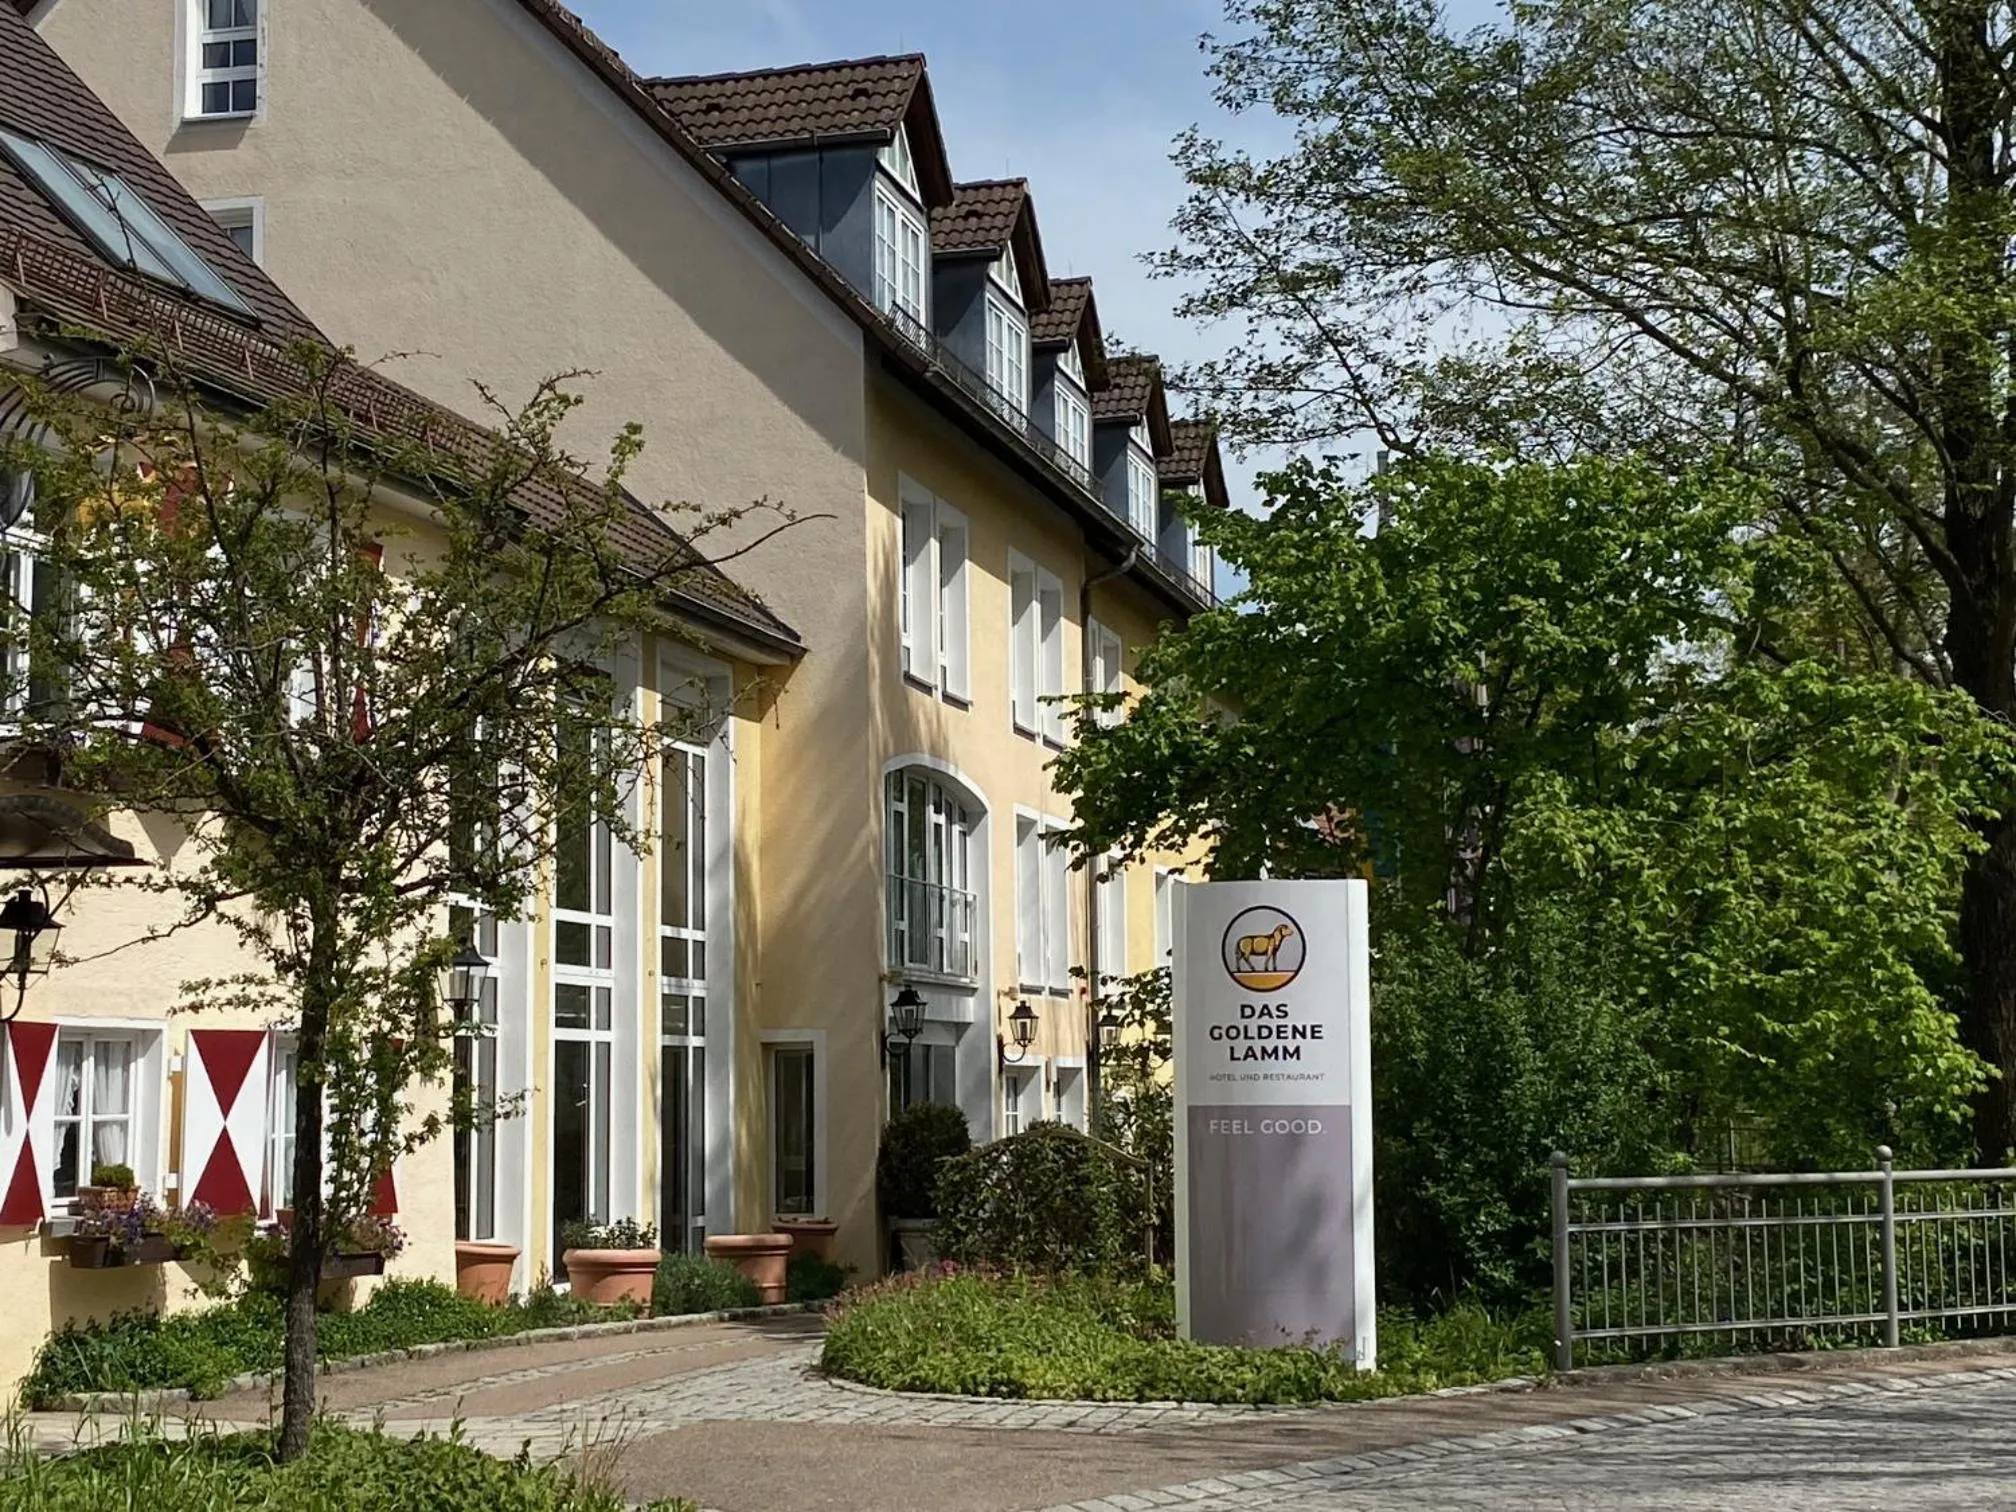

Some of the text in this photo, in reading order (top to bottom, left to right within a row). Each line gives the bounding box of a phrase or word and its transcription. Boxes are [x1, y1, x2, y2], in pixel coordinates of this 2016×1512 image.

[1240, 1003, 1289, 1019] DAS
[1209, 1024, 1324, 1041] GOLDENE
[1229, 1045, 1301, 1062] LAMM
[1209, 1072, 1325, 1082] HOTEL UND RESTAURANT
[1209, 1119, 1254, 1135] FEEL
